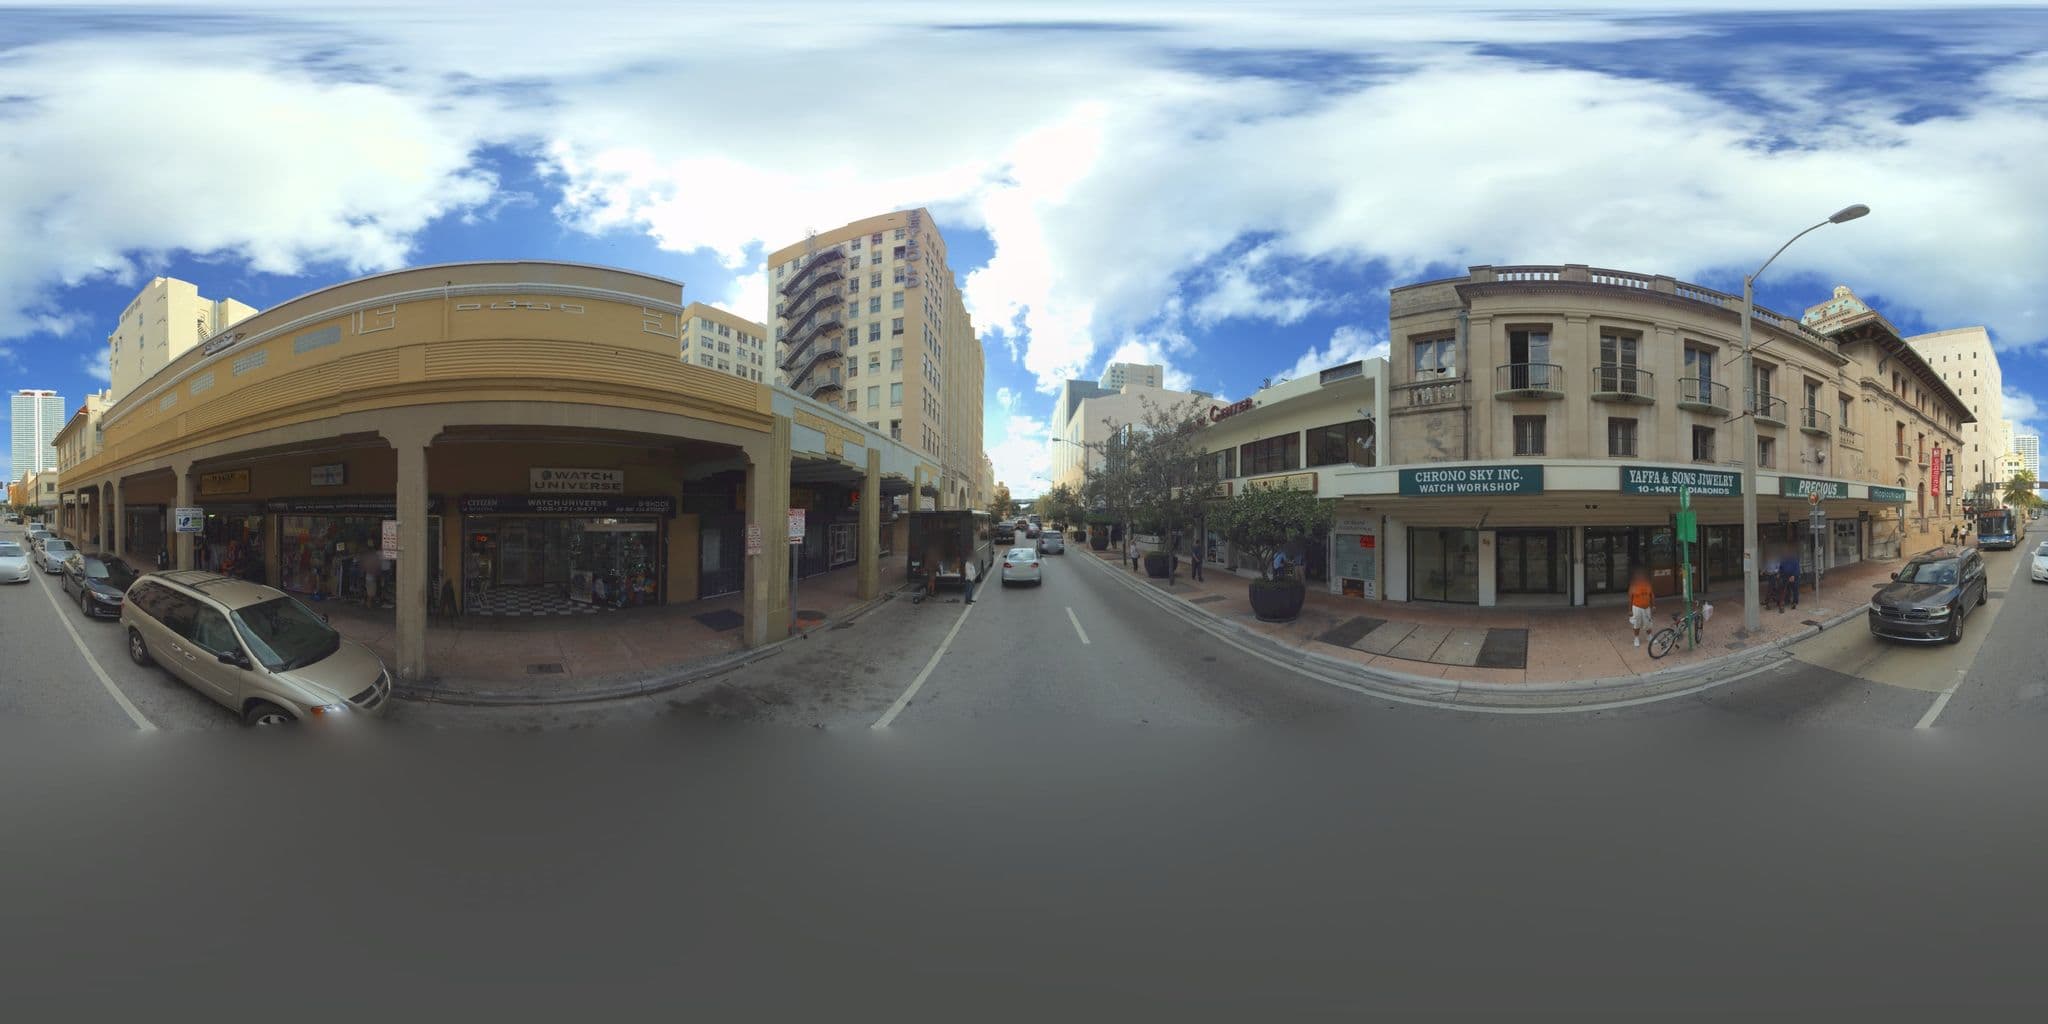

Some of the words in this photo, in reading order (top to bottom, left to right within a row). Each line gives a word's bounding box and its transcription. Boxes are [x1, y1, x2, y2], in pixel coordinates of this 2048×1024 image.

[554, 471, 613, 481] WATCH
[1415, 470, 1466, 482] CHRONO
[1469, 469, 1494, 481] SKY
[1497, 469, 1523, 481] INC.
[1629, 470, 1661, 484] YAFFA
[1662, 472, 1669, 484] &
[1671, 471, 1696, 486] SONS
[534, 481, 622, 490] UNIVERSE
[1418, 483, 1453, 493] WATCH
[1456, 482, 1520, 493] WORKSHOP
[1799, 481, 1838, 496] PRECIOUS
[528, 498, 560, 507] WATCH
[561, 498, 608, 507] UNIVERSE
